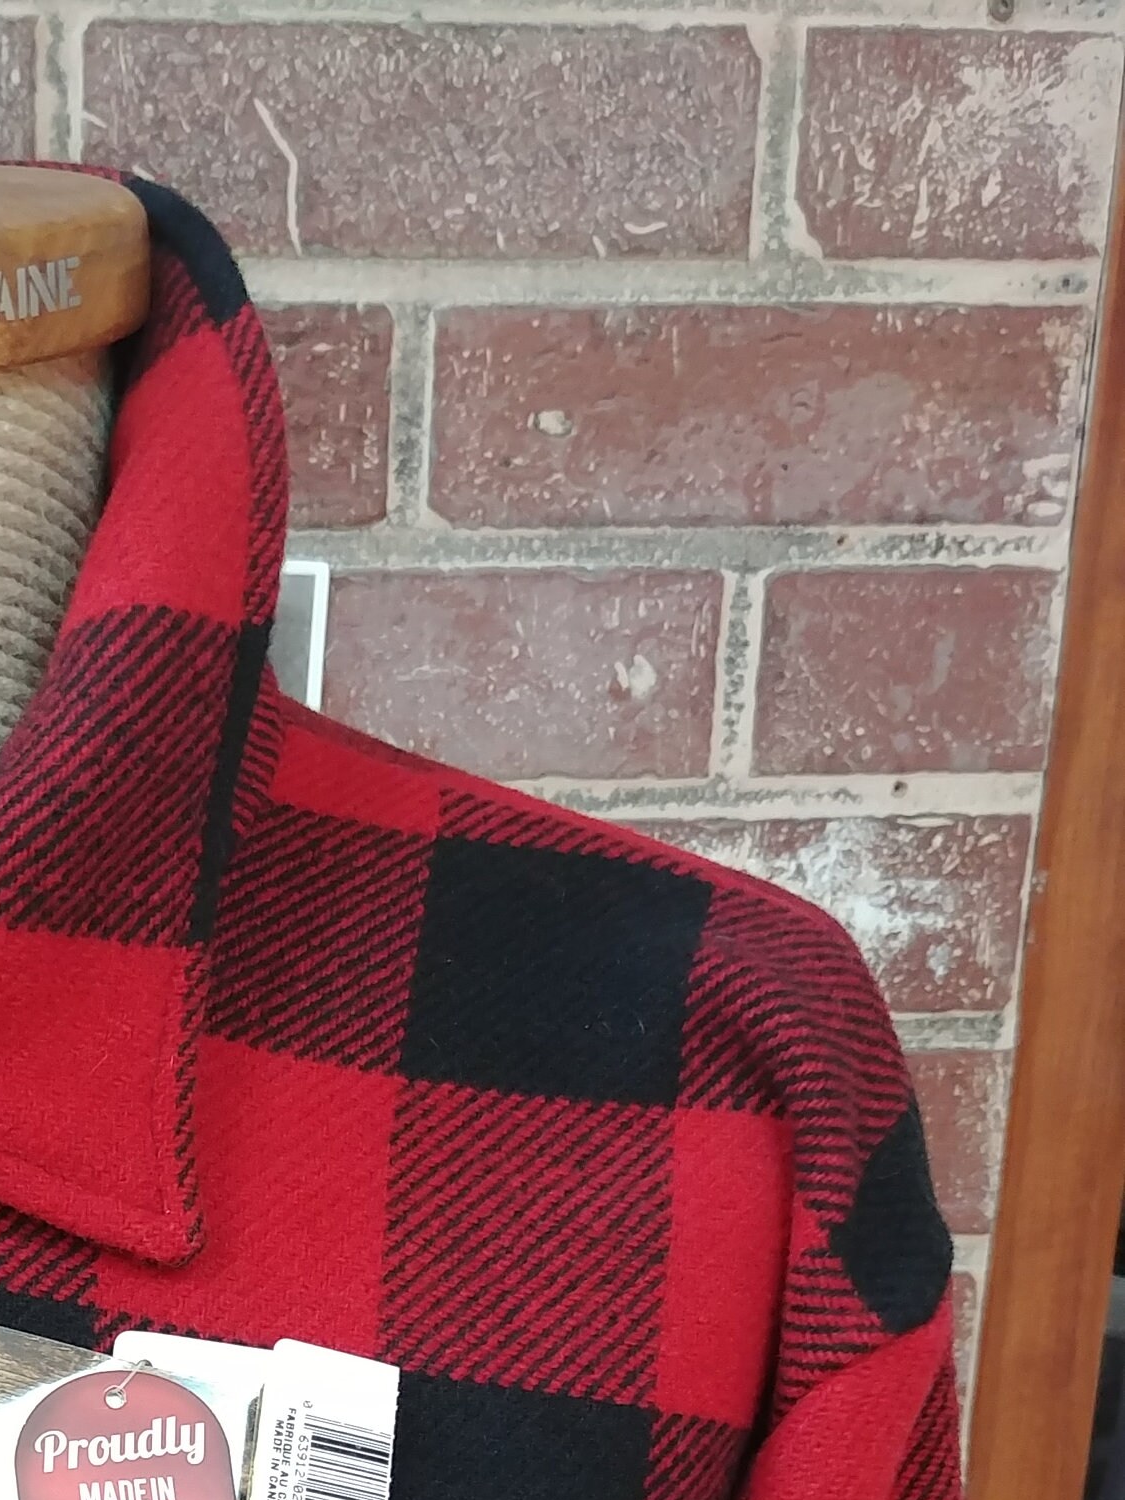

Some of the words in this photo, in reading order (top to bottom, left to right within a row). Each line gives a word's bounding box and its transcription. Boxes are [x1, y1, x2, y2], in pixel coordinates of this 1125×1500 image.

[34, 1416, 205, 1473] Proudly
[281, 1407, 297, 1466] FABRIQUE
[295, 1435, 309, 1478] 63912
[271, 1458, 280, 1471] IN
[279, 1471, 289, 1487] AU
